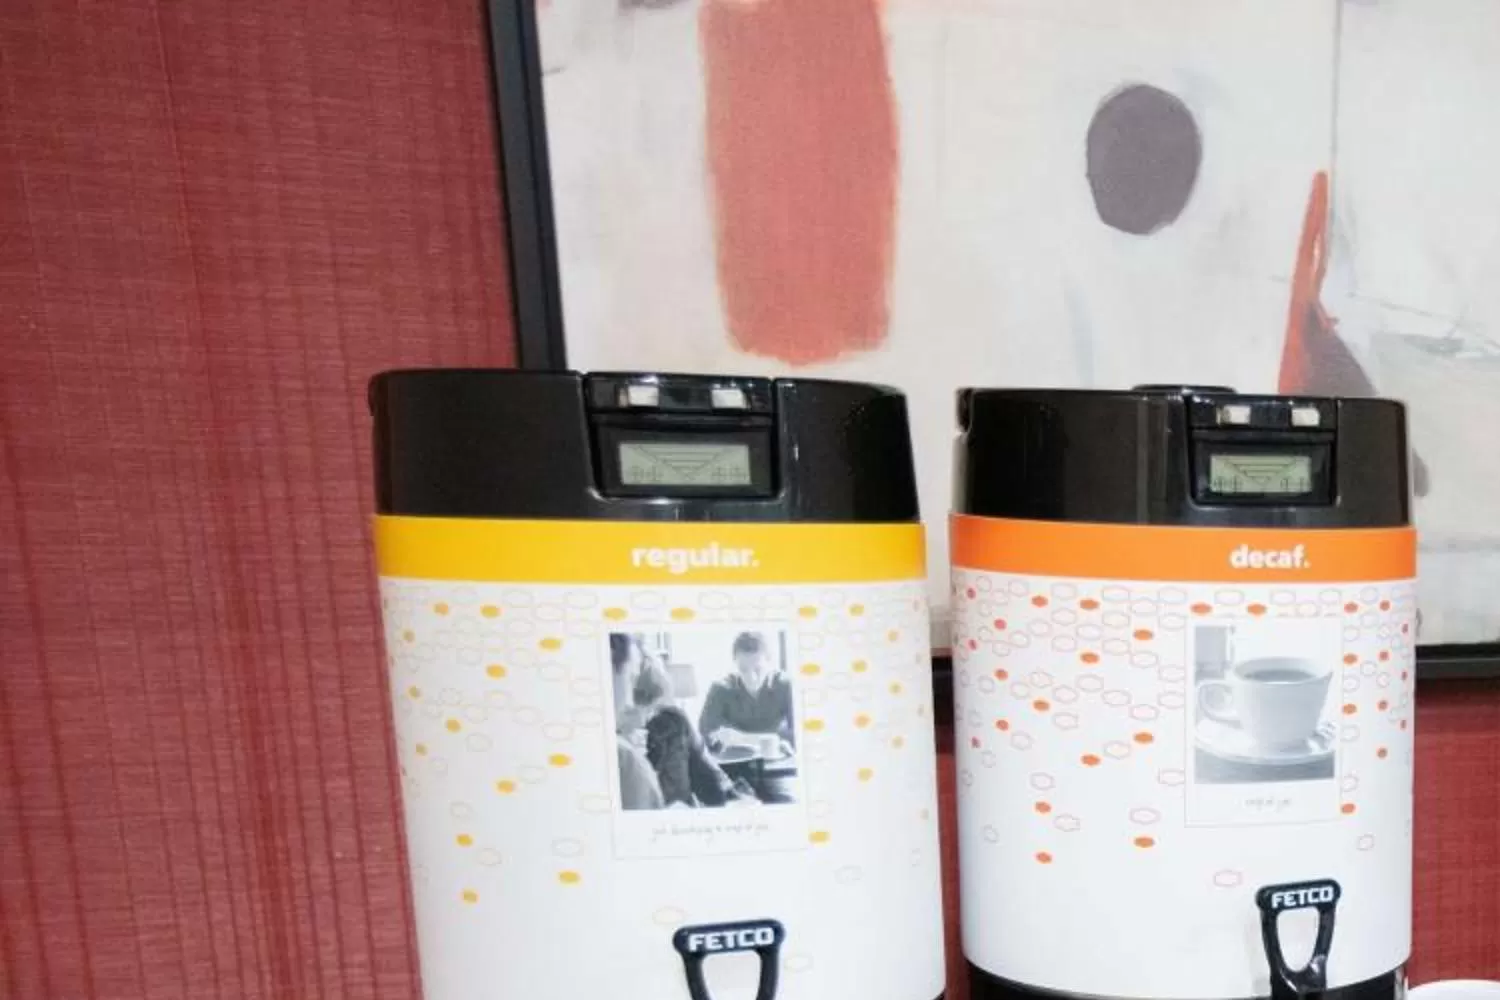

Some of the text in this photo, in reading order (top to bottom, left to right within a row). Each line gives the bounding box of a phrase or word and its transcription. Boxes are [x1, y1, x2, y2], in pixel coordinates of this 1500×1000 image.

[631, 540, 760, 575] regular.
[1230, 543, 1311, 569] decaf.
[1271, 885, 1335, 909] FETCO
[687, 926, 775, 952] FETCO
